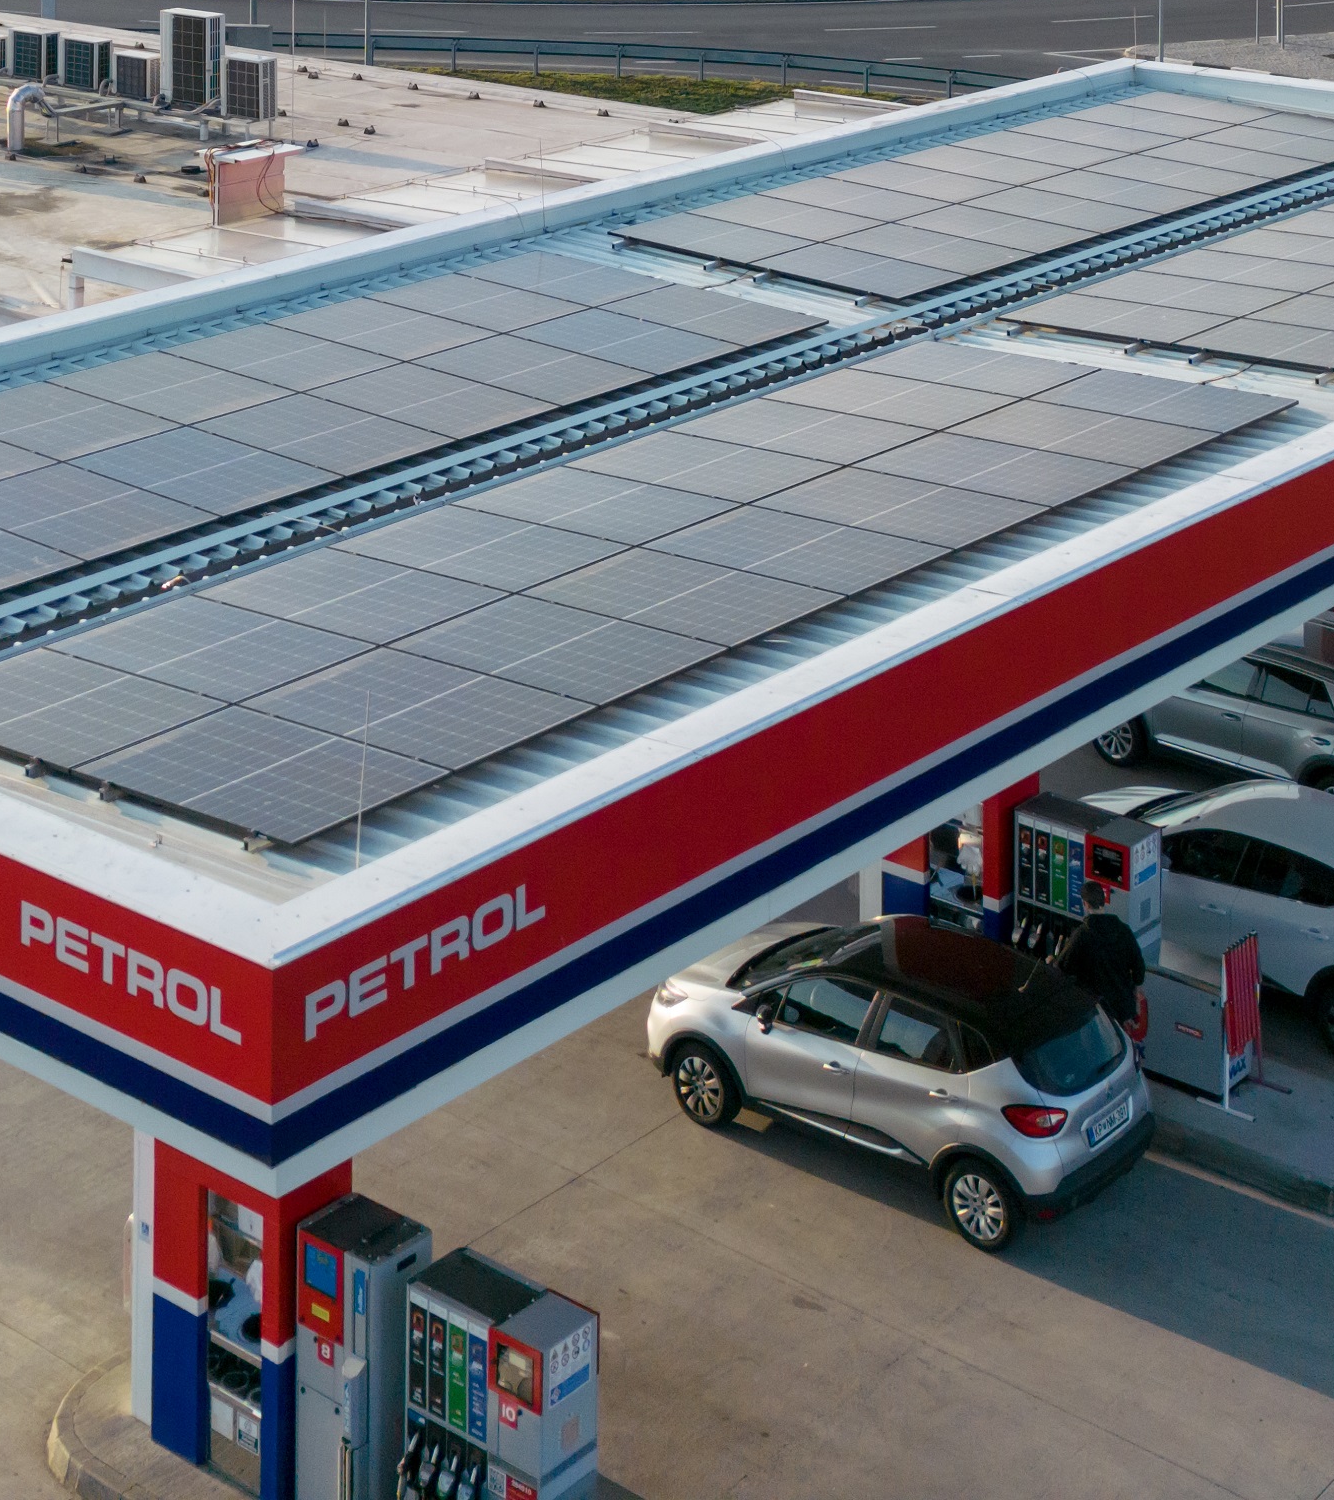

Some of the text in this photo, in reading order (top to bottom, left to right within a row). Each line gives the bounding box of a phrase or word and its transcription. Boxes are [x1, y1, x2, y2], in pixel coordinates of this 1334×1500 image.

[20, 900, 242, 1046] PETROL
[304, 883, 546, 1043] PETROL
[321, 1344, 330, 1360] 8
[501, 1404, 516, 1422] 10
